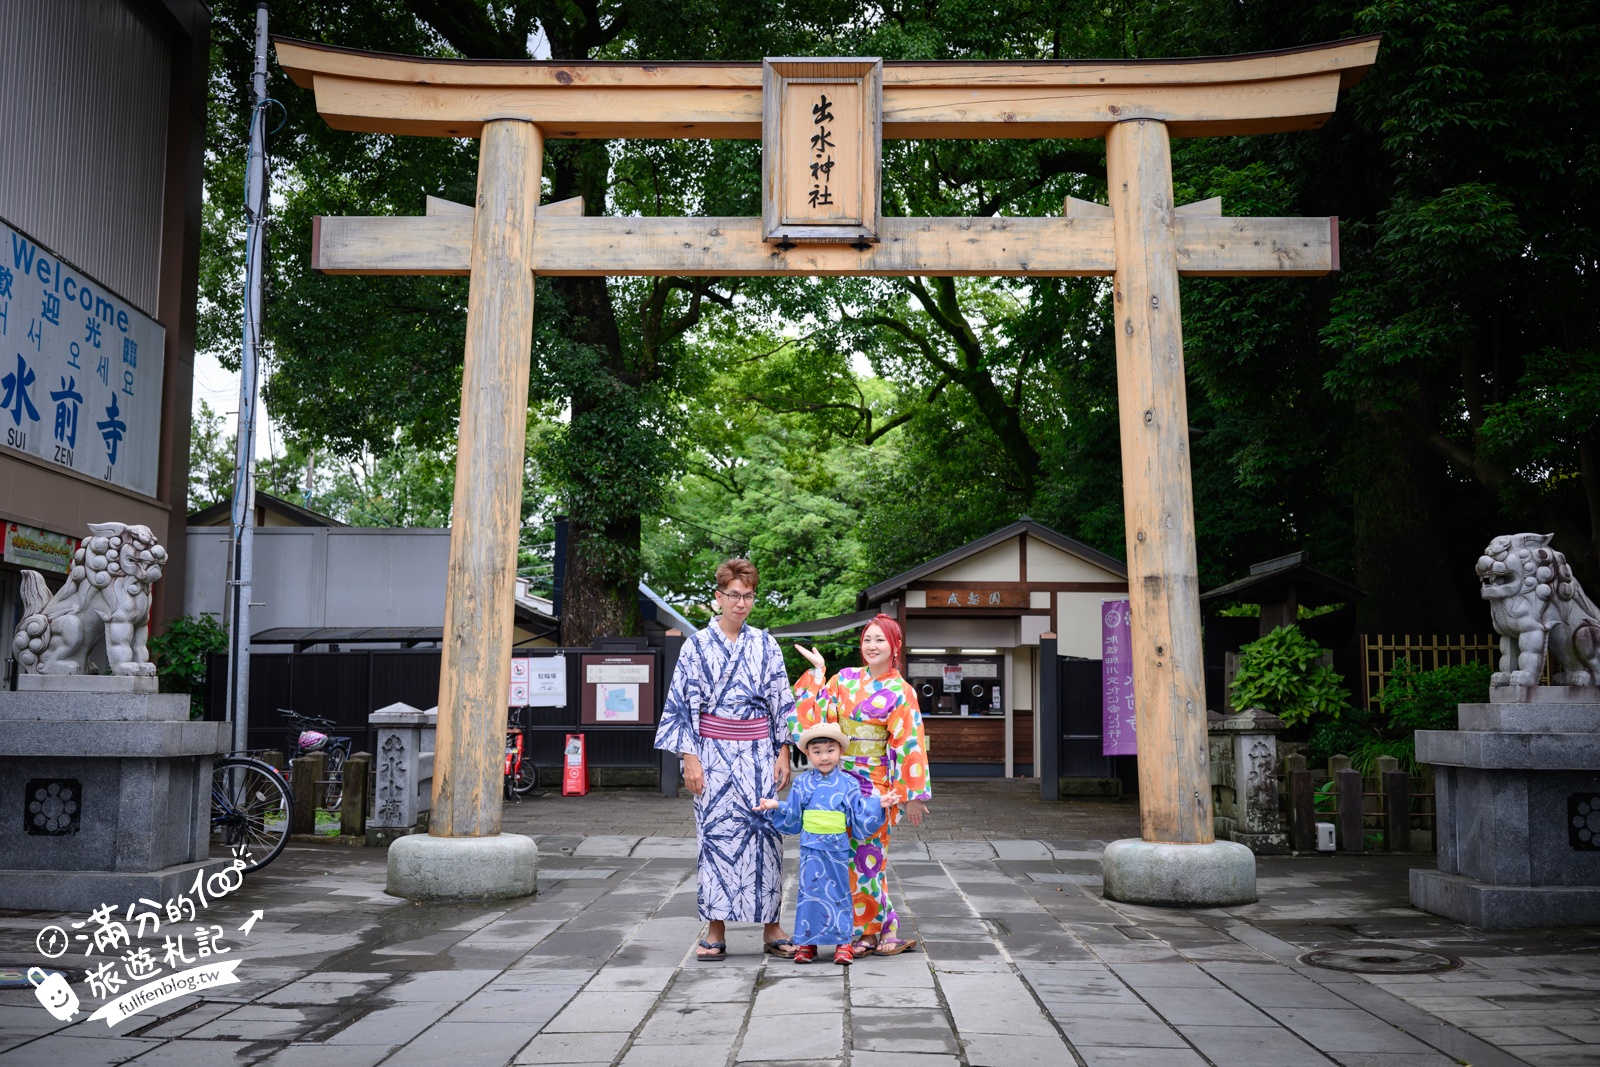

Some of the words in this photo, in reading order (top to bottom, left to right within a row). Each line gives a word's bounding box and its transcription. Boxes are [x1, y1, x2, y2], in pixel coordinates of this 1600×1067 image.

[808, 94, 836, 209] 出水神社
[12, 232, 129, 333] Welcome
[1, 353, 127, 465] 水前寺
[7, 428, 26, 450] SUI
[54, 445, 74, 467] ZEN
[103, 466, 112, 481] JI
